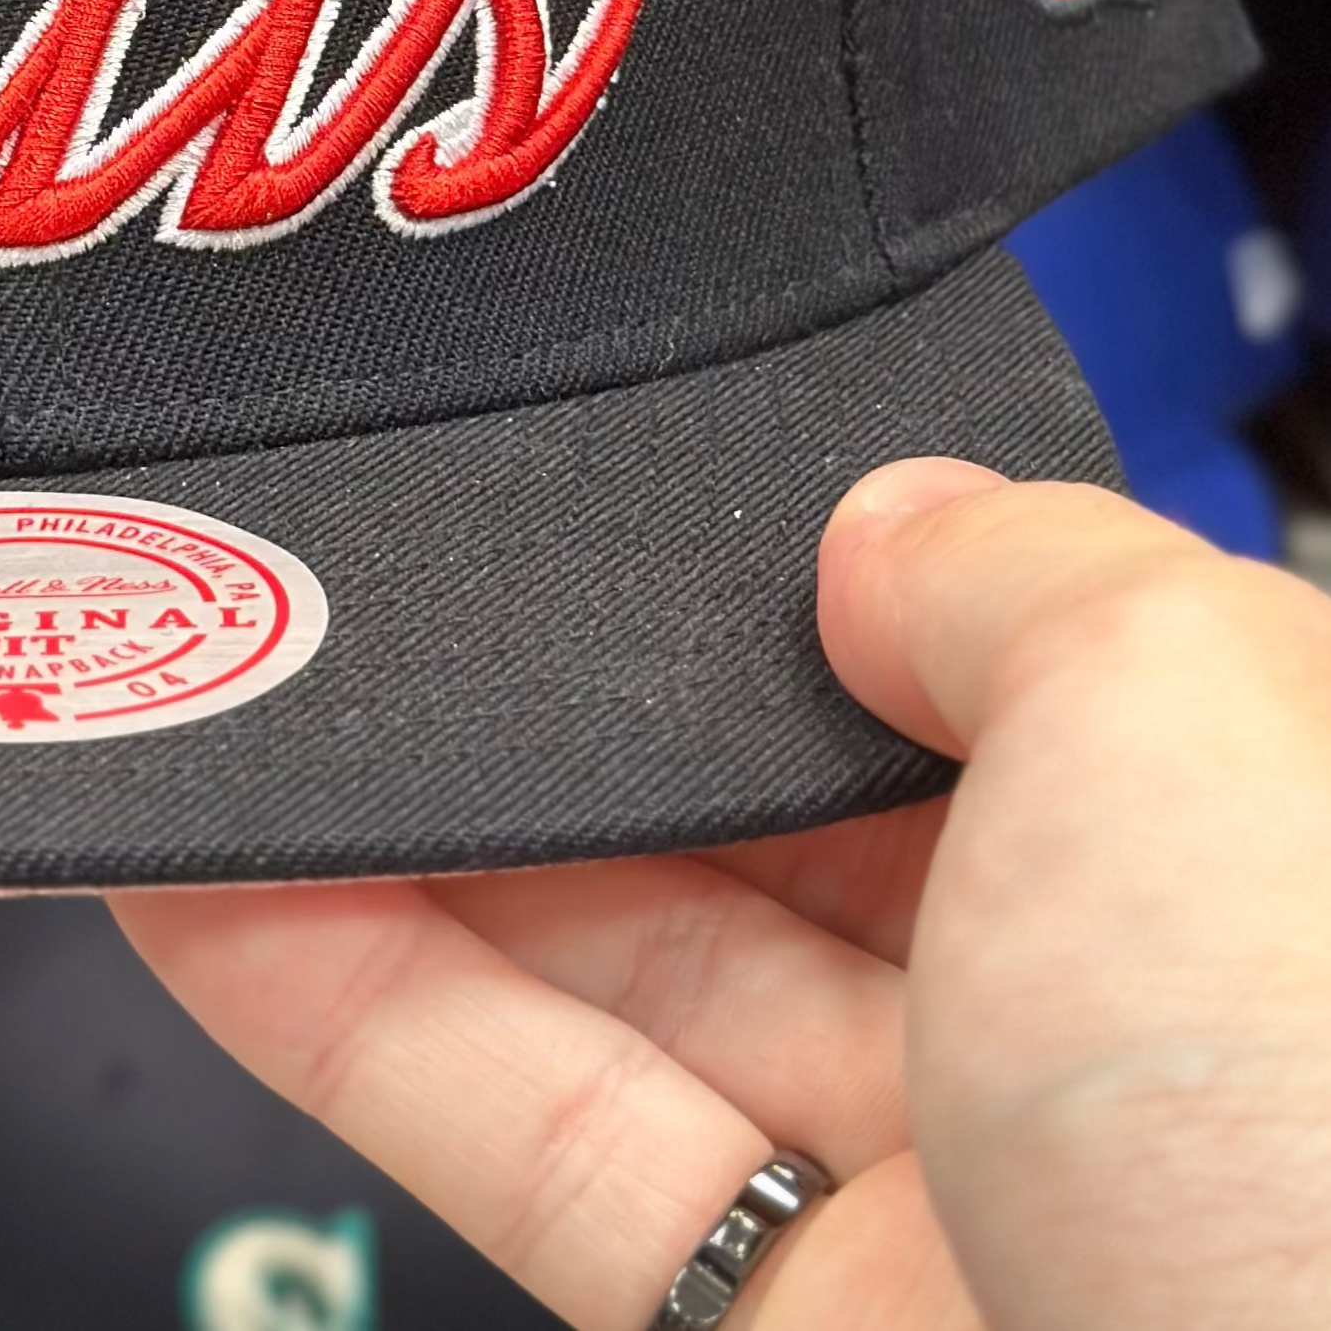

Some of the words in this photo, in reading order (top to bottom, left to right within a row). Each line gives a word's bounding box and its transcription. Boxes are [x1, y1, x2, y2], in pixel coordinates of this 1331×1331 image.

[16, 518, 236, 579] PHILADELPHIA,
[224, 581, 261, 601] PA
[41, 579, 67, 593] &
[76, 575, 178, 593] Ness
[127, 671, 189, 698] 04
